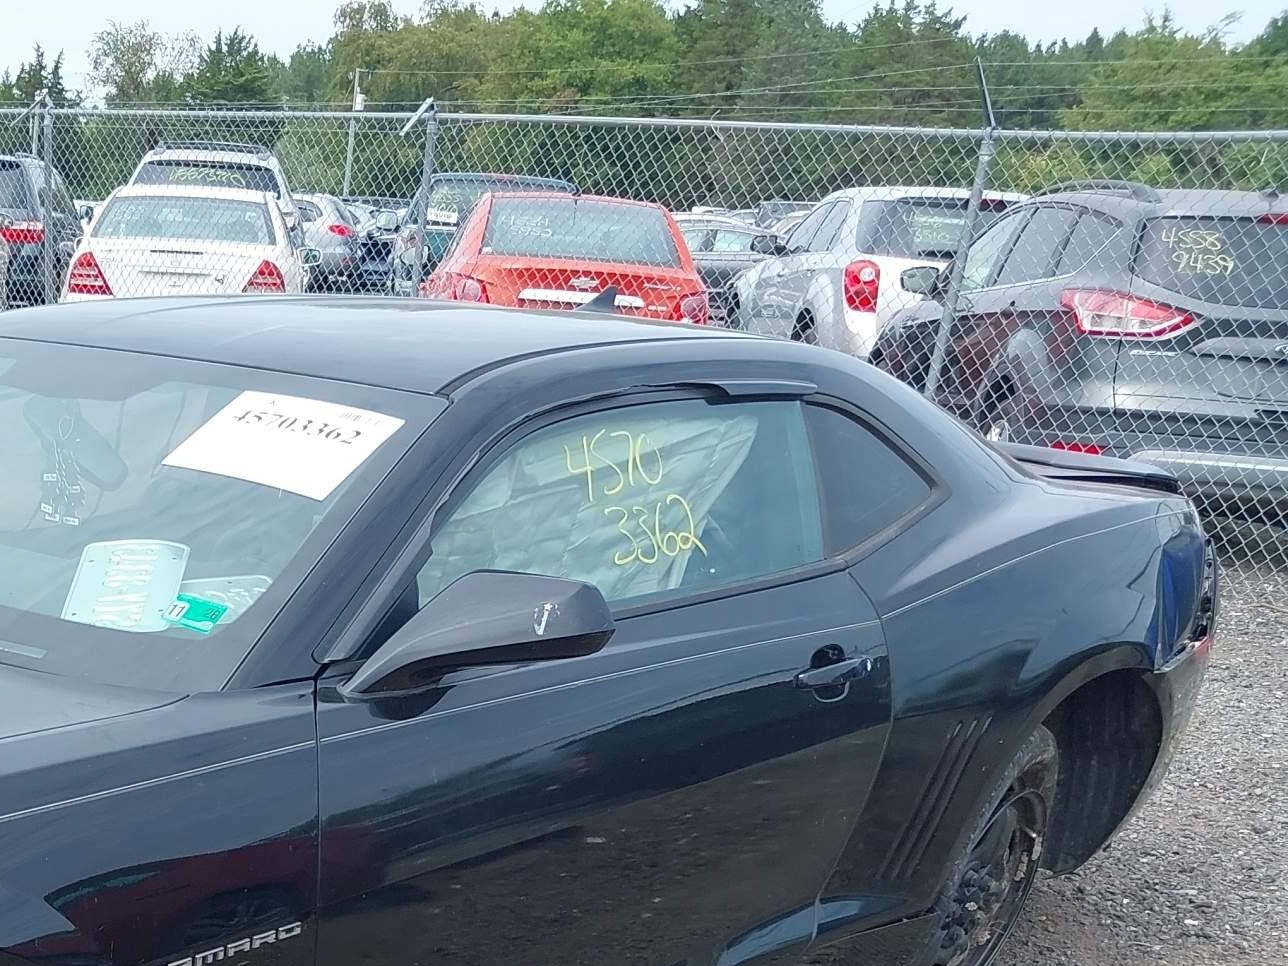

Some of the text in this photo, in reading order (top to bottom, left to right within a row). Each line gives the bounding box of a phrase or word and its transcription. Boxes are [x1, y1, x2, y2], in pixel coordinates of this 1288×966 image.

[1161, 227, 1222, 250] 4558
[1172, 251, 1235, 275] 9439
[232, 409, 363, 446] 45703362
[564, 428, 664, 502] 4570
[604, 494, 709, 565] 3362
